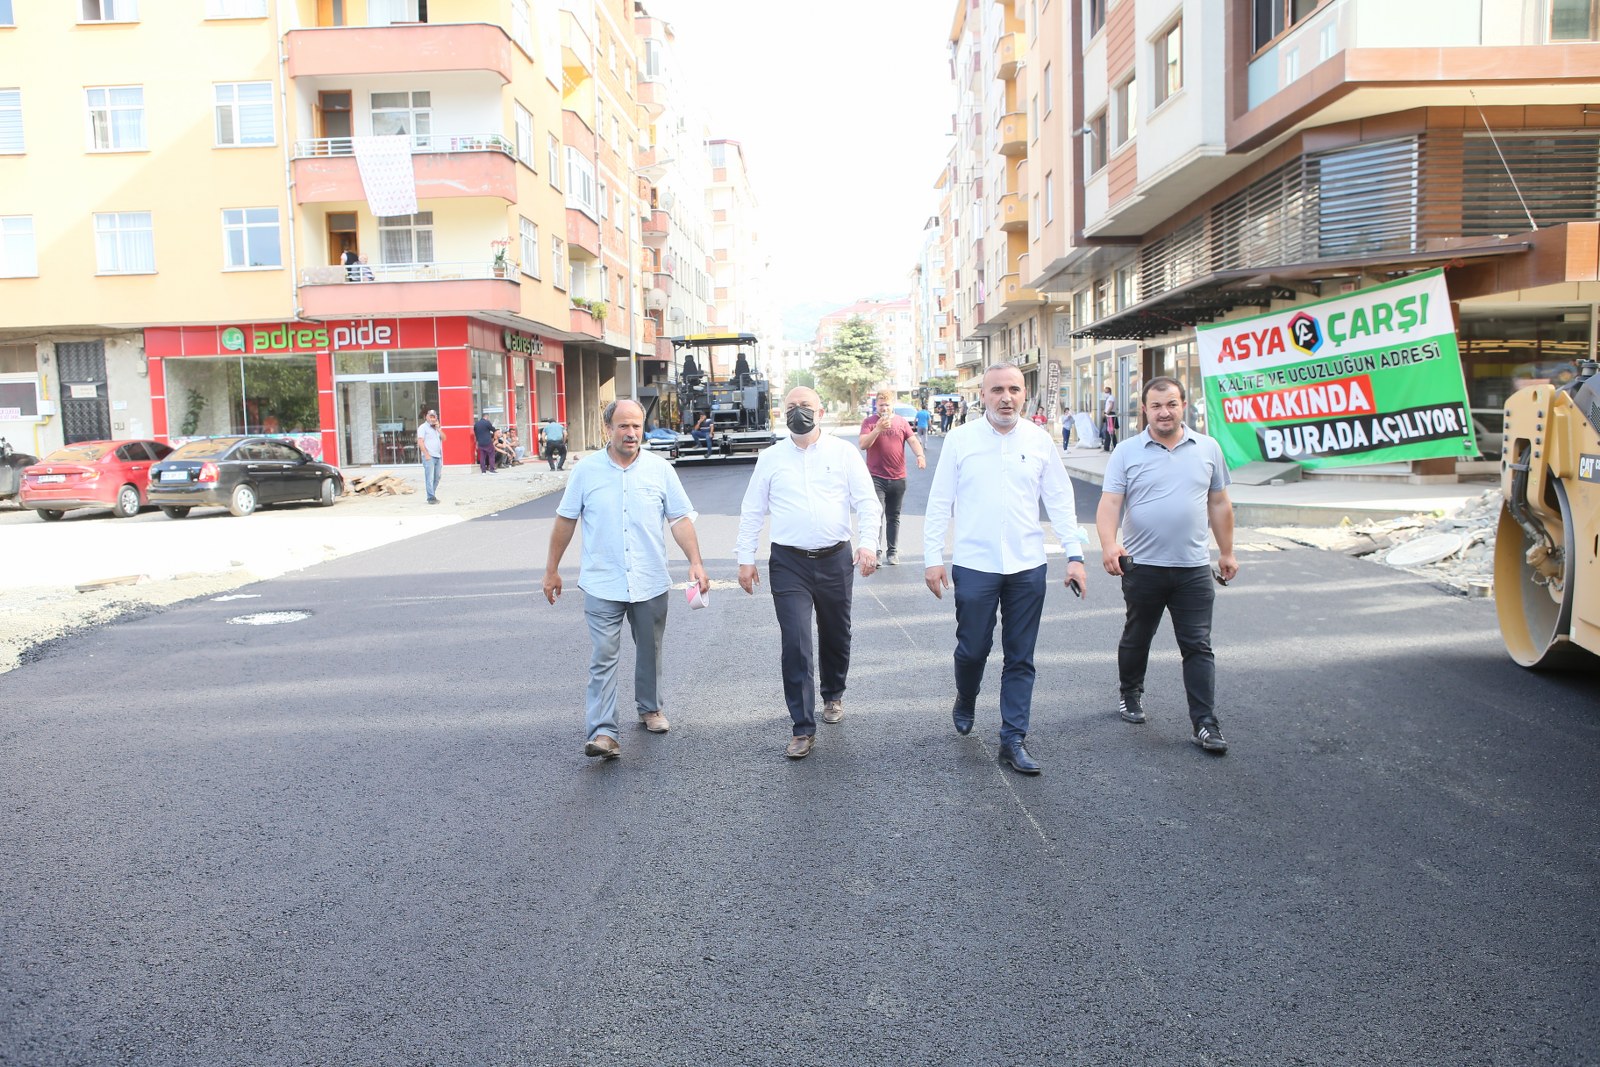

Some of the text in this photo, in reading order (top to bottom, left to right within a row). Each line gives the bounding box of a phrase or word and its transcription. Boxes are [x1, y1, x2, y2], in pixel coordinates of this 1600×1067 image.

[254, 320, 391, 350] adres pide
[1218, 326, 1285, 363] ASYA
[1327, 293, 1429, 347] ÇARŞI
[1267, 370, 1287, 386] VE
[1287, 356, 1376, 382] UCUZLUĞUN
[1224, 381, 1371, 423] ÇOK YAKINDA
[1264, 420, 1369, 459] BURADA
[1580, 456, 1595, 478] CAT
